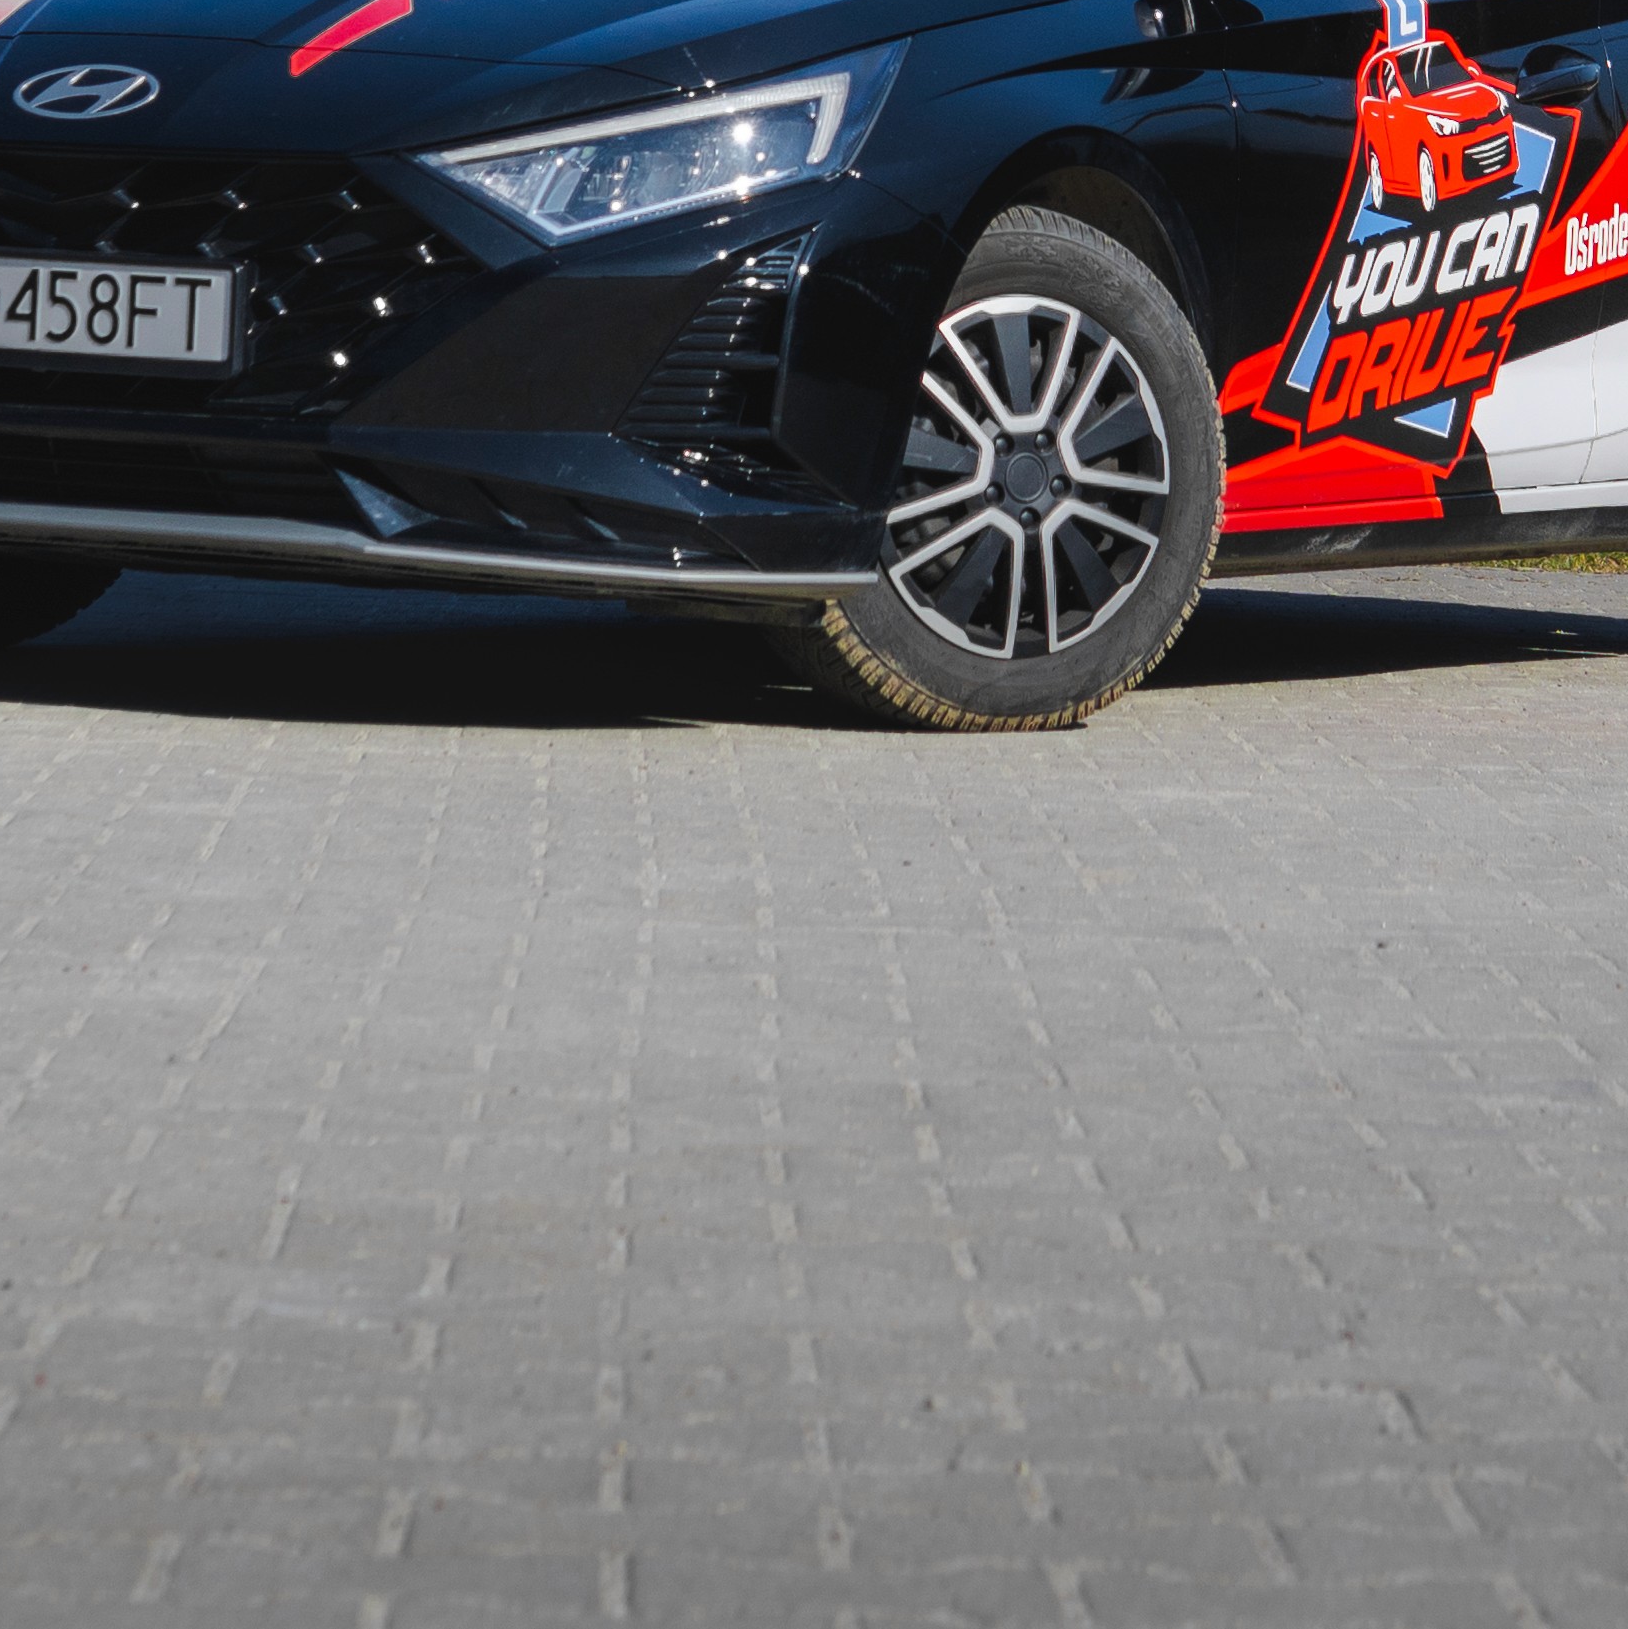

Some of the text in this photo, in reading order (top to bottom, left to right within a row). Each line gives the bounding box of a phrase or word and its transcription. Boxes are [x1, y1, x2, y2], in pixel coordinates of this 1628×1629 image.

[4, 268, 213, 352] 458FT
[1333, 203, 1540, 325] YOU CAN
